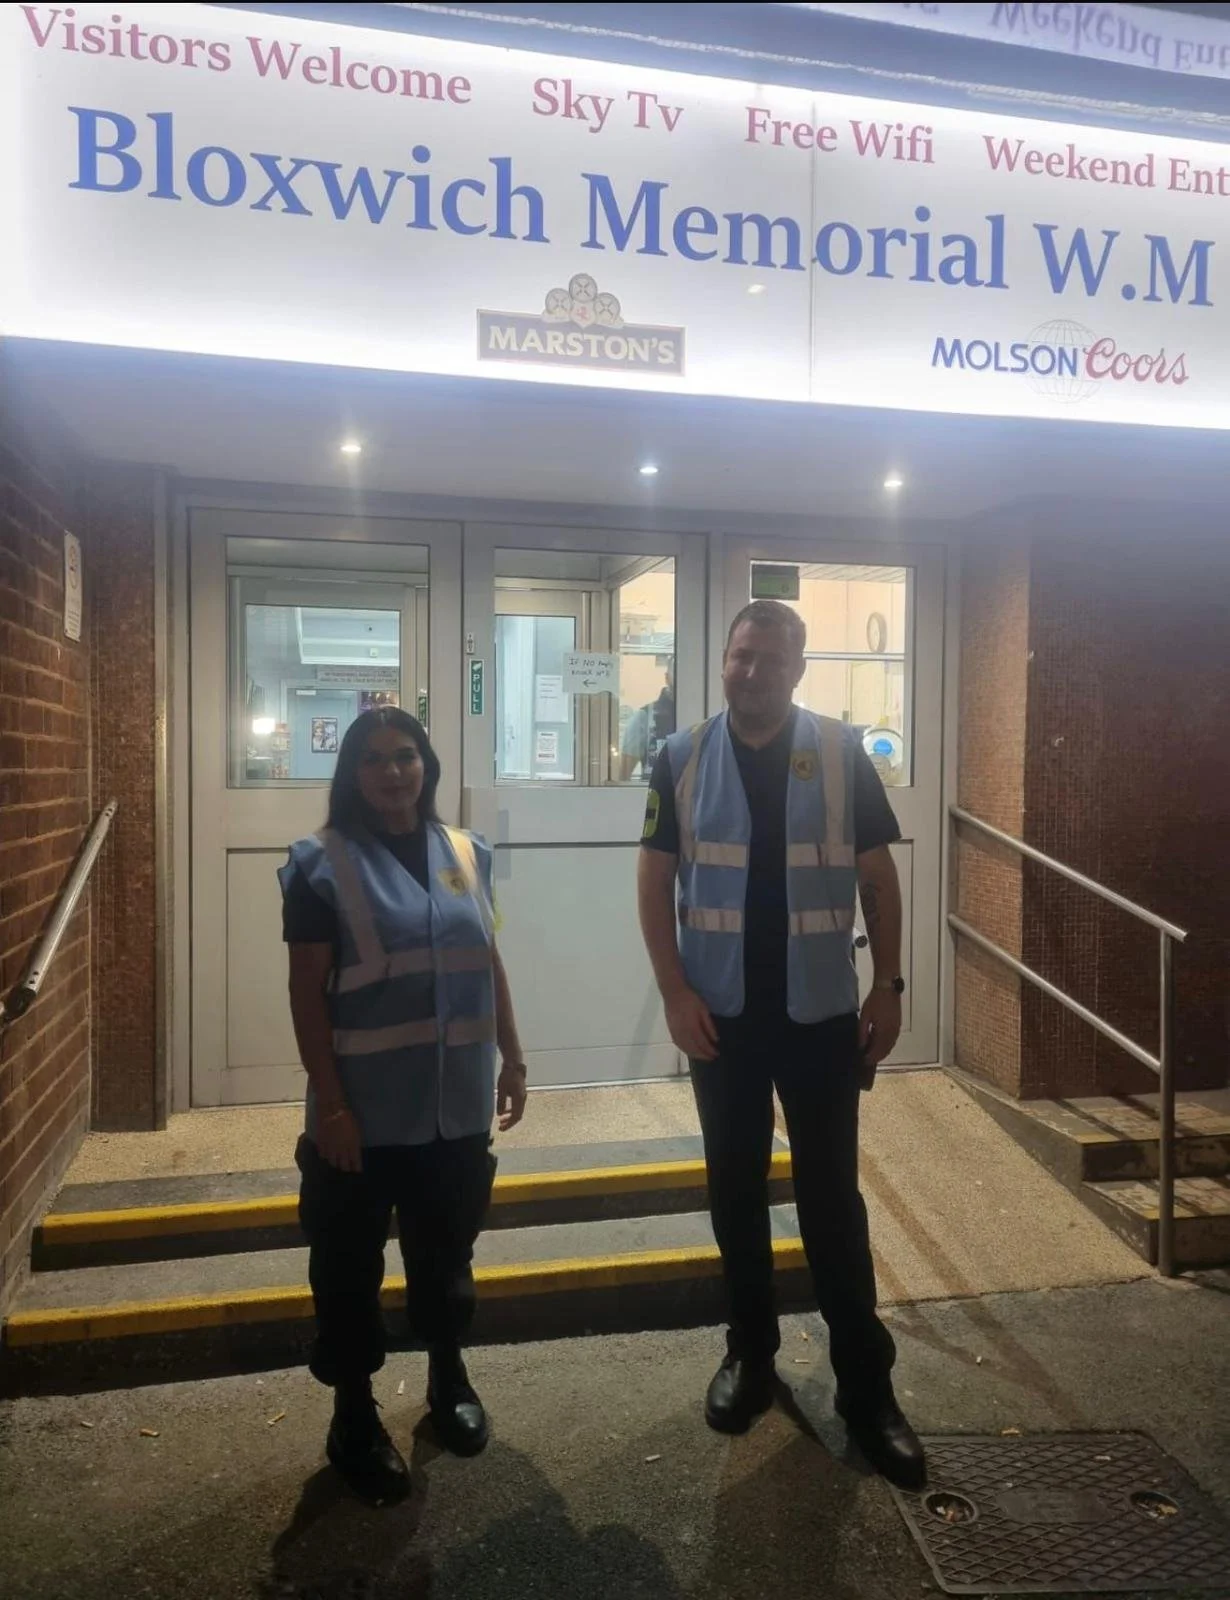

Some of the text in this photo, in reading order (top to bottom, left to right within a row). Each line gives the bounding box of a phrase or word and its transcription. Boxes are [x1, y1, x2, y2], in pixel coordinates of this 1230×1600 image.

[19, 5, 231, 71] Visitors
[246, 36, 471, 104] Welcome
[532, 78, 614, 133] Sky
[628, 91, 684, 132] Tv
[745, 107, 837, 152] Free
[849, 120, 935, 163] Wifi
[983, 135, 1156, 188] Weekend
[67, 106, 1215, 307] Bloxwich Memorial W.M
[489, 325, 676, 364] MARSTON'S
[931, 337, 1190, 385] MOLSON Coors
[473, 674, 481, 712] PULL
